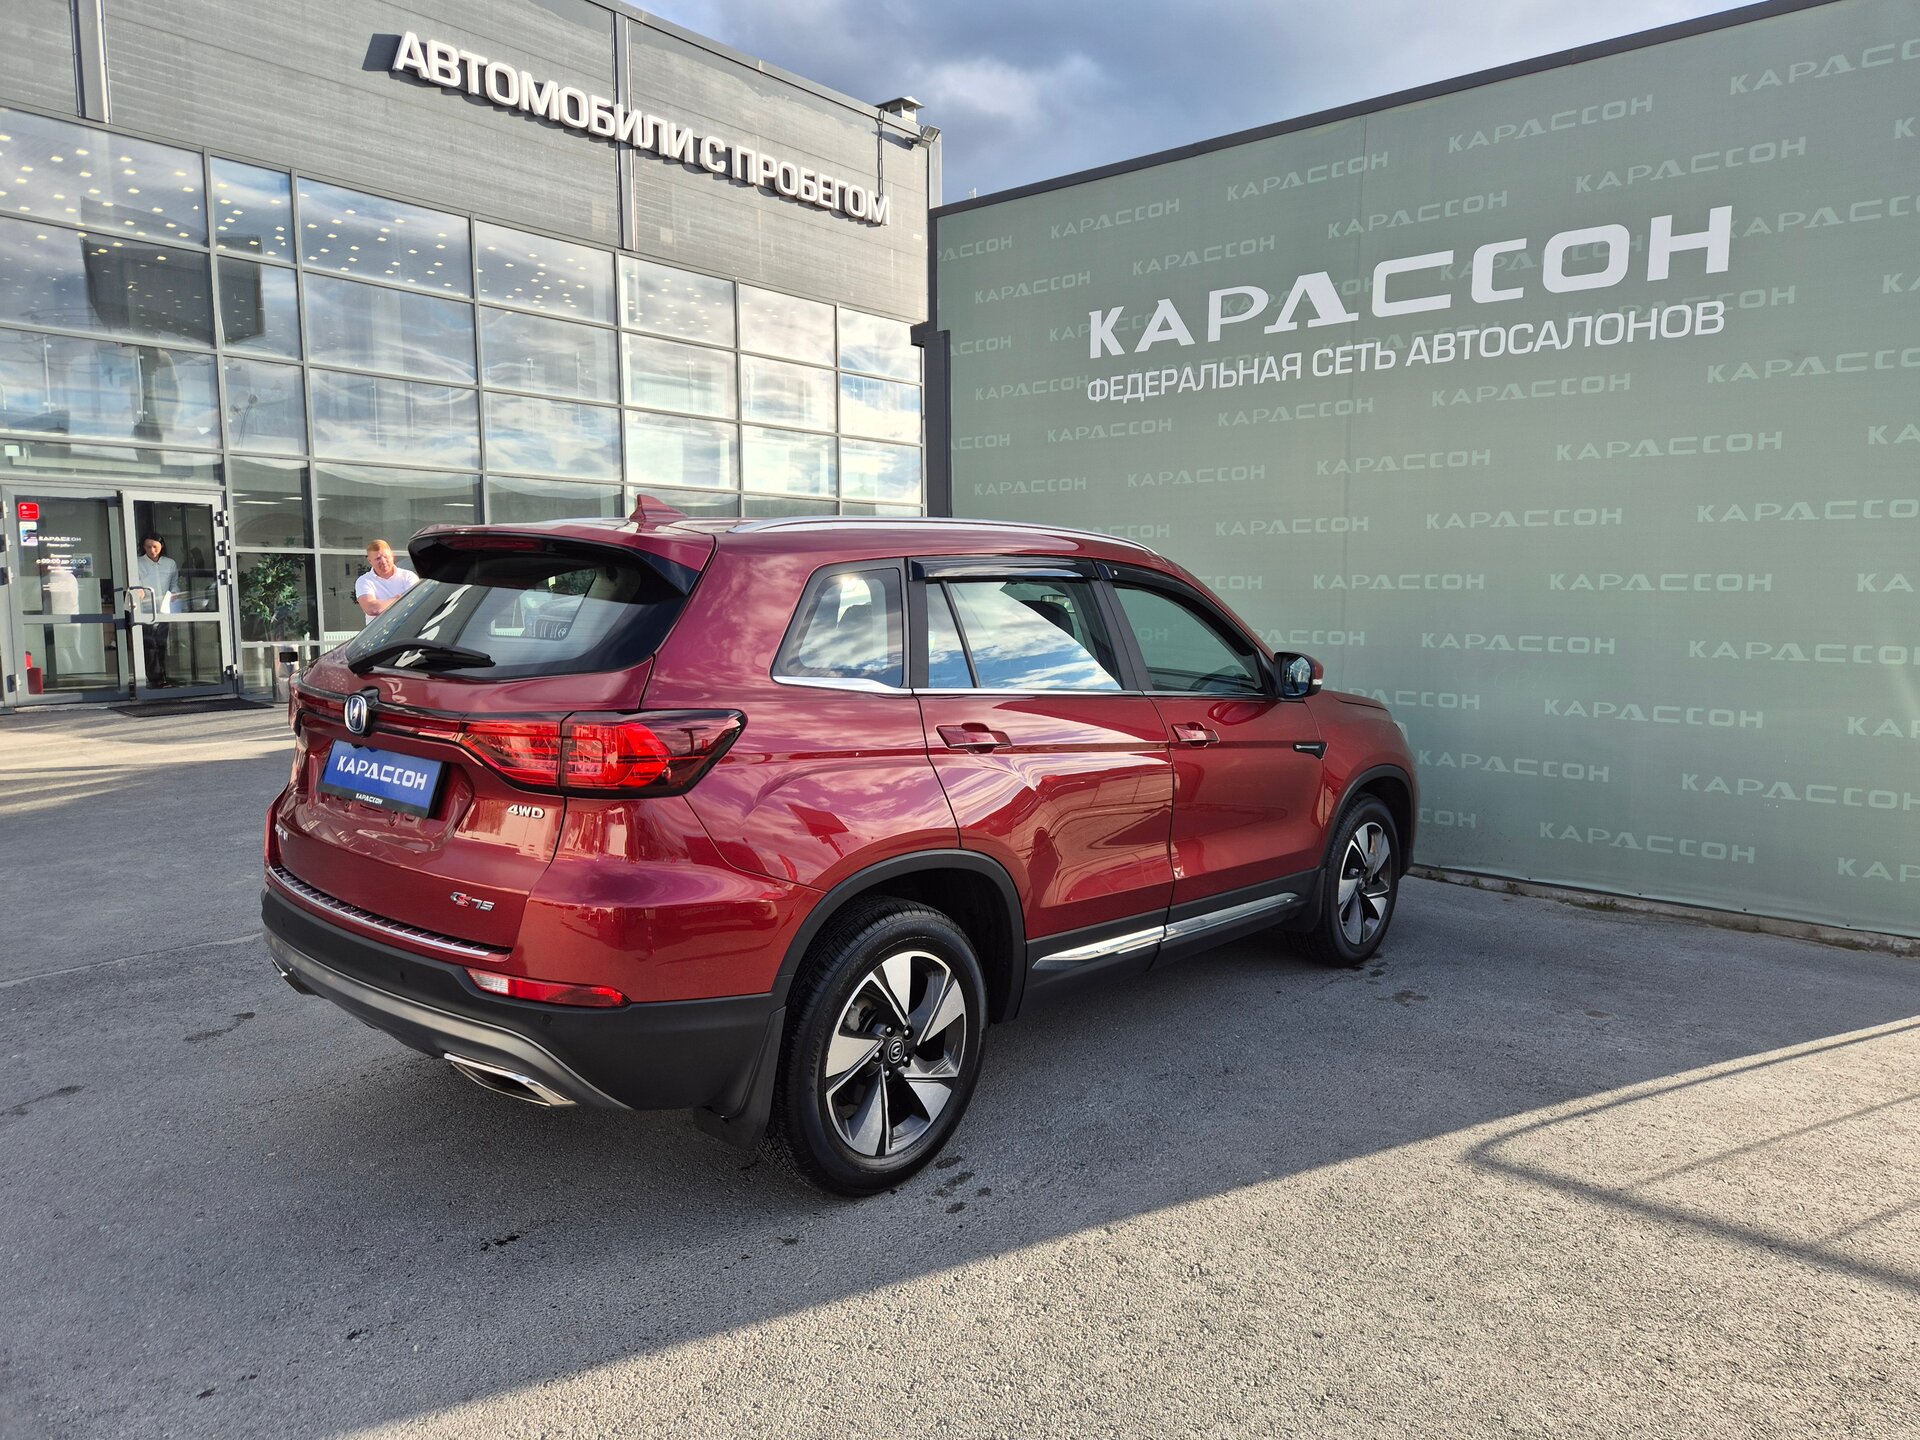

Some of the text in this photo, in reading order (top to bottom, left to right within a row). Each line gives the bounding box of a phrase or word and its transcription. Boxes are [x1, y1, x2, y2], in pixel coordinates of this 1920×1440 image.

[392, 31, 890, 226] АВТОМОБИЛИ С ПРОБЕГОМ
[1448, 94, 1654, 153] КАРАССОН
[1227, 151, 1388, 201] КАРАССОН
[1576, 136, 1807, 194] КАРАССОН
[1050, 198, 1180, 240] КАРАССОН
[1328, 190, 1508, 239] КАРАССОН
[1132, 234, 1276, 276] КАРАССОН
[975, 270, 1091, 304] КАРАССОН
[1089, 205, 1732, 359] КАРАССОН
[1087, 300, 1725, 404] ФЕДЕРАЛЬНАЯ СЕТЬ АВТОСАЛОНОВ
[1431, 372, 1632, 408] КАРАССОН
[1218, 396, 1374, 428] КАРАССОН
[1047, 418, 1173, 444] КАРАССОН
[1556, 431, 1783, 462] КАРАССОН
[1127, 464, 1266, 489] КАРАССОН
[1316, 449, 1491, 476] КАРАССОН
[974, 476, 1088, 497] КАРАССОН
[1215, 516, 1369, 537] КАРАССОН
[1426, 507, 1623, 530] КАРАССОН
[1313, 573, 1485, 591] КАРАССОН
[1549, 573, 1773, 592] КАРАССОН
[1421, 632, 1616, 656] КАРАССОН
[1544, 698, 1764, 729] КАРАССОН
[336, 755, 428, 791] КАРАССОН
[1418, 750, 1610, 783] КАРАССОН
[506, 803, 545, 820] 4WD
[1538, 821, 1756, 865] КАРАССОН
